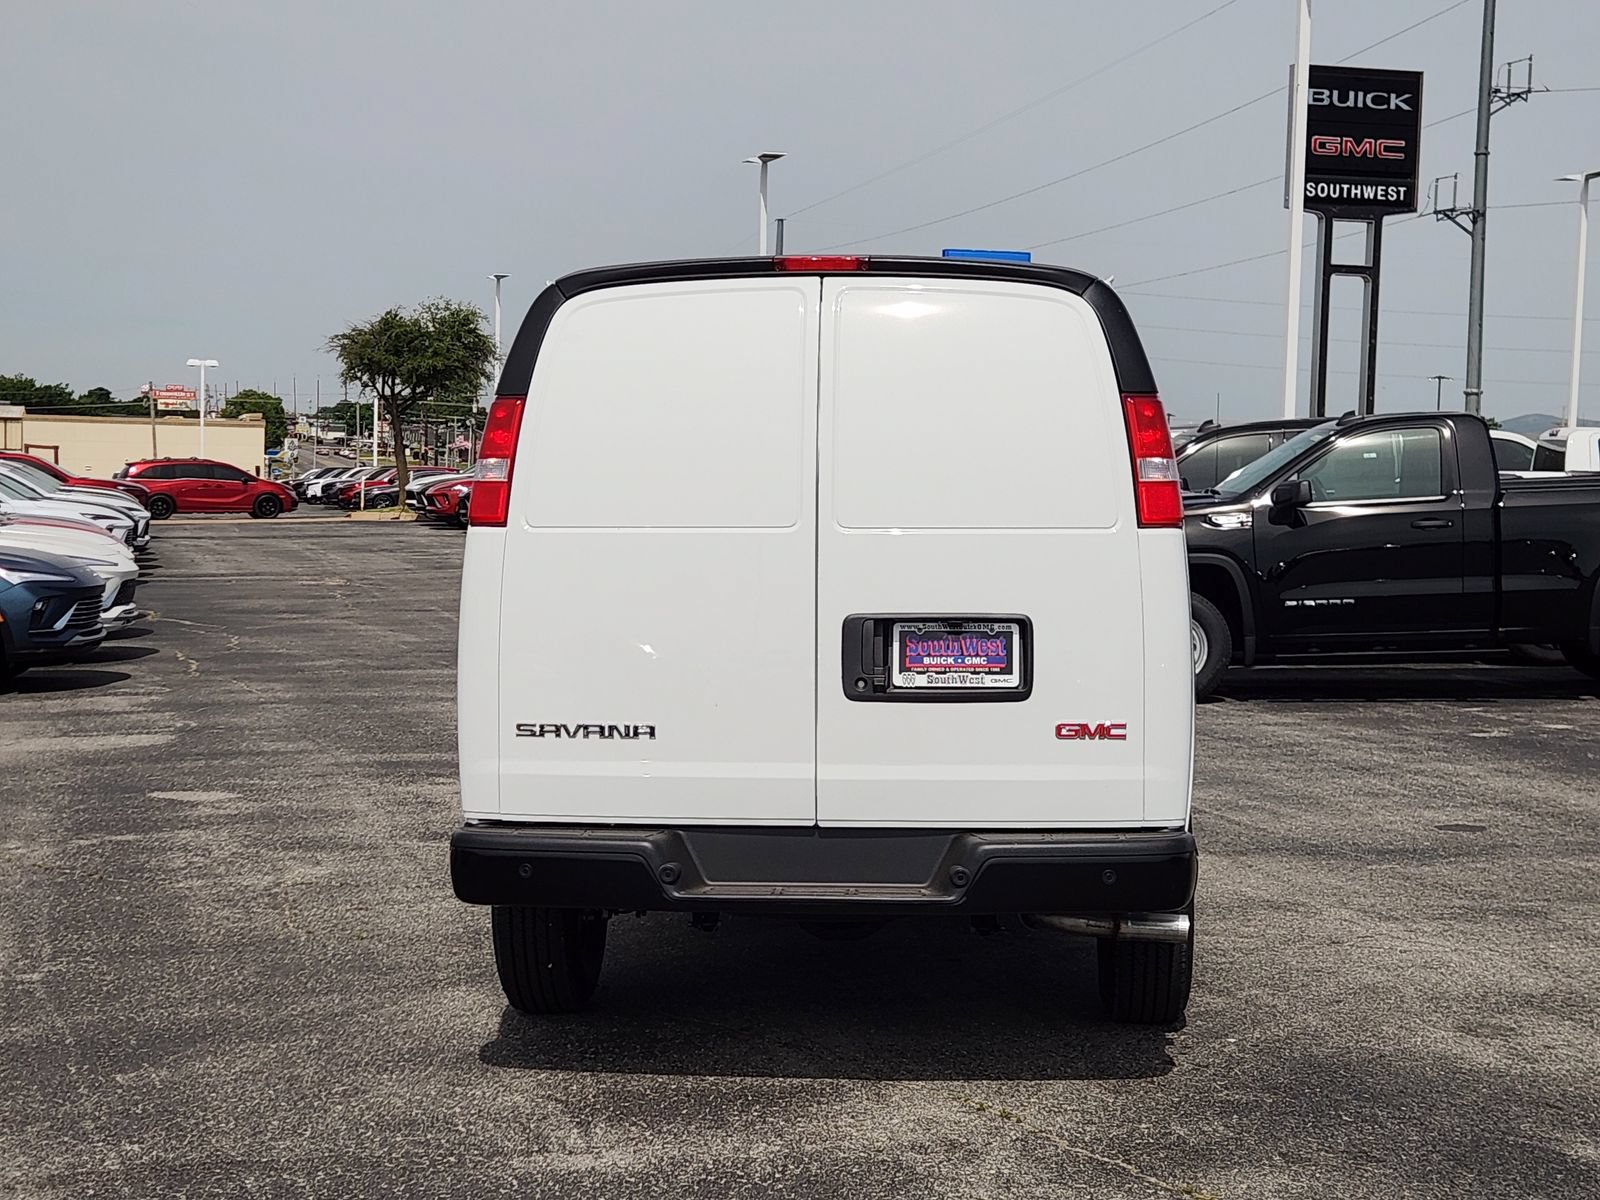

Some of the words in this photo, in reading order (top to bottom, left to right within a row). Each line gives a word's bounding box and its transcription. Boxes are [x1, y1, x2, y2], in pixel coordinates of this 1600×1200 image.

[1308, 88, 1413, 111] BUICK
[1311, 135, 1406, 159] GMC
[1306, 182, 1407, 201] SOUTHWEST
[923, 656, 955, 665] BUICK
[964, 656, 988, 665] GMC
[516, 723, 656, 739] SAVANA
[1055, 723, 1127, 740] GMC
